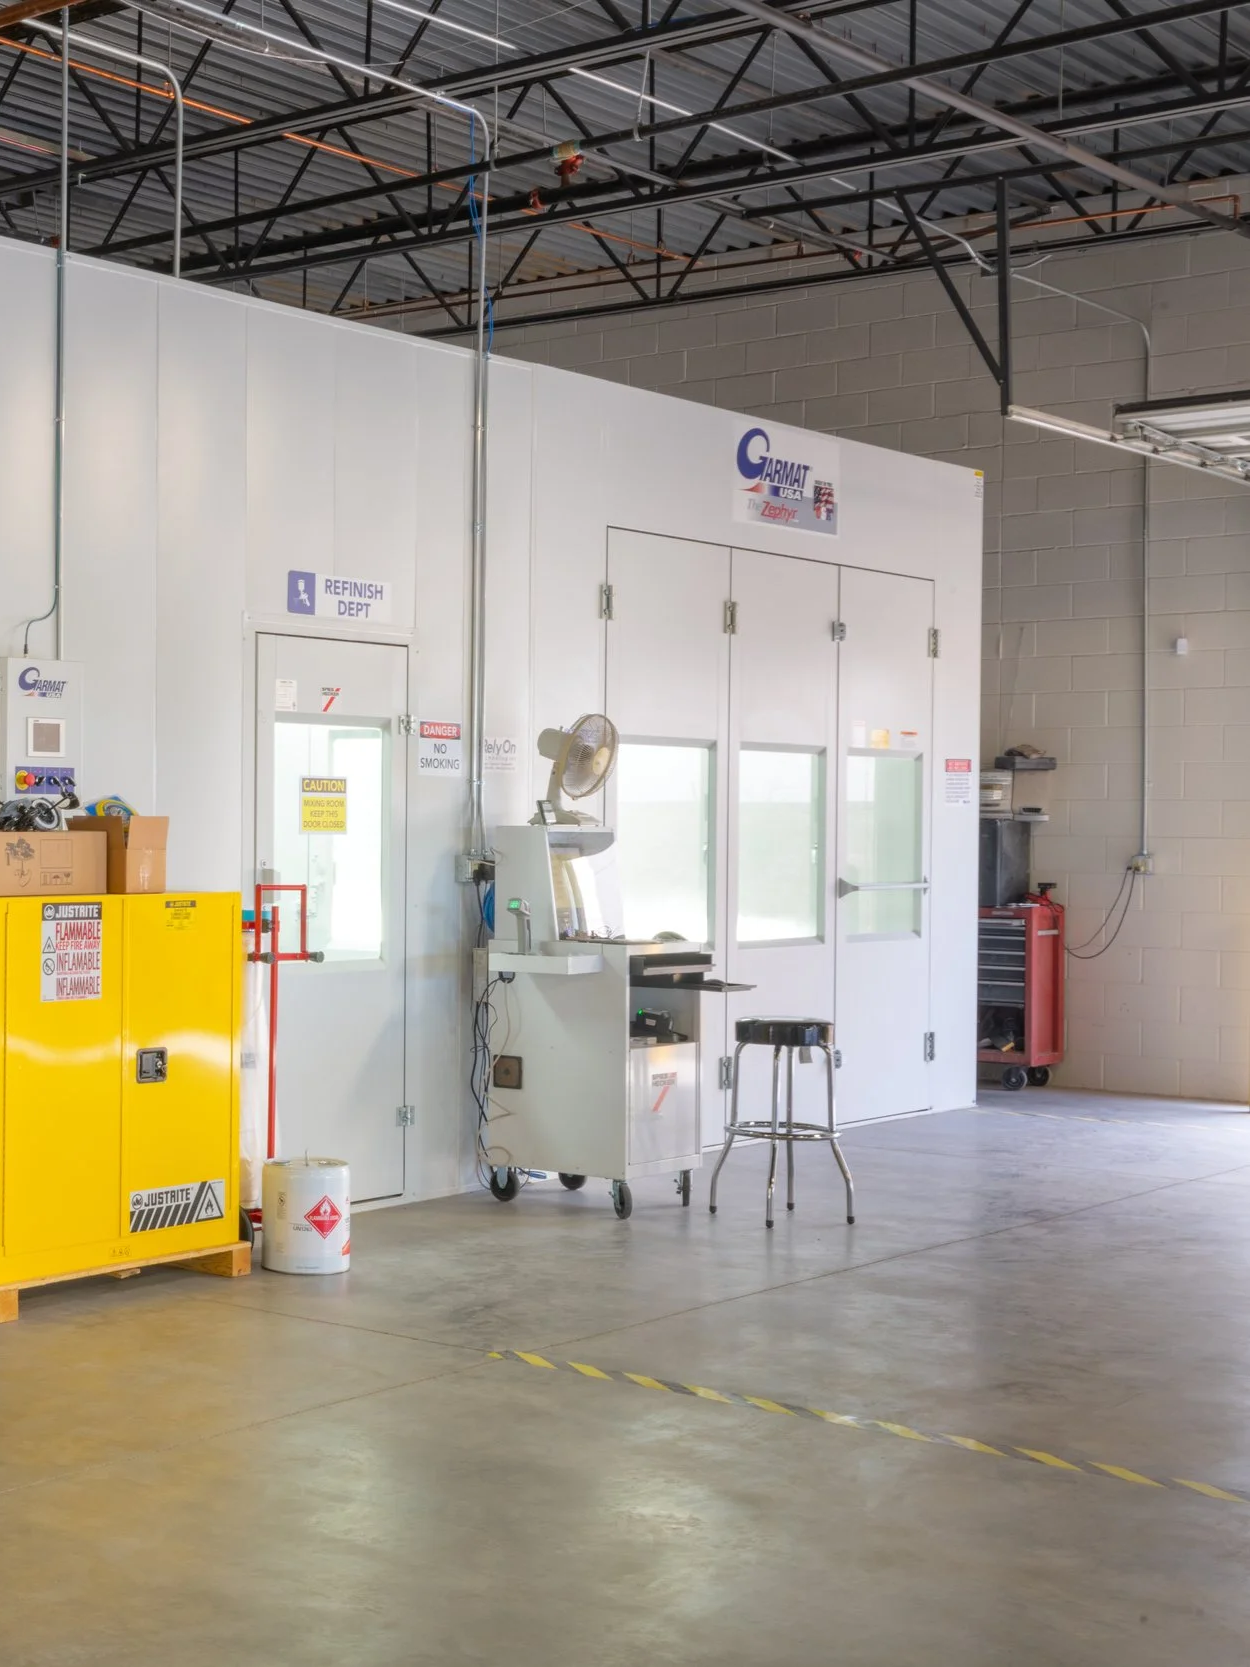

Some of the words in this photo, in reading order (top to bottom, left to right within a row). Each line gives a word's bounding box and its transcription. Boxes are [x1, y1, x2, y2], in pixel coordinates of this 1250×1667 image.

[736, 427, 810, 489] GARMAT
[779, 487, 803, 501] USA
[760, 500, 799, 524] Zephyr
[324, 578, 384, 601] REFINISH
[337, 599, 371, 619] DEPT
[18, 666, 67, 693] GARMAT
[423, 724, 458, 737] DANGER
[433, 743, 447, 754] NO
[420, 757, 460, 770] SMOKING
[303, 779, 345, 792] CAUTION
[303, 799, 326, 808] MIXING
[326, 799, 345, 808] ROOM
[310, 810, 325, 818] KEEP
[325, 810, 339, 818] THIS
[303, 820, 321, 828] DOOR
[321, 820, 345, 828] CLOSED
[55, 904, 99, 919] JUSTRITE
[55, 921, 101, 941] FLAMMABLE
[55, 941, 69, 951] KEEP
[70, 941, 83, 951] FIRE
[84, 940, 100, 950] AWAY
[56, 951, 100, 971] INFLAMABLE
[55, 976, 100, 997] INFLAMMABLE
[144, 1187, 191, 1207] JUSTRITE
